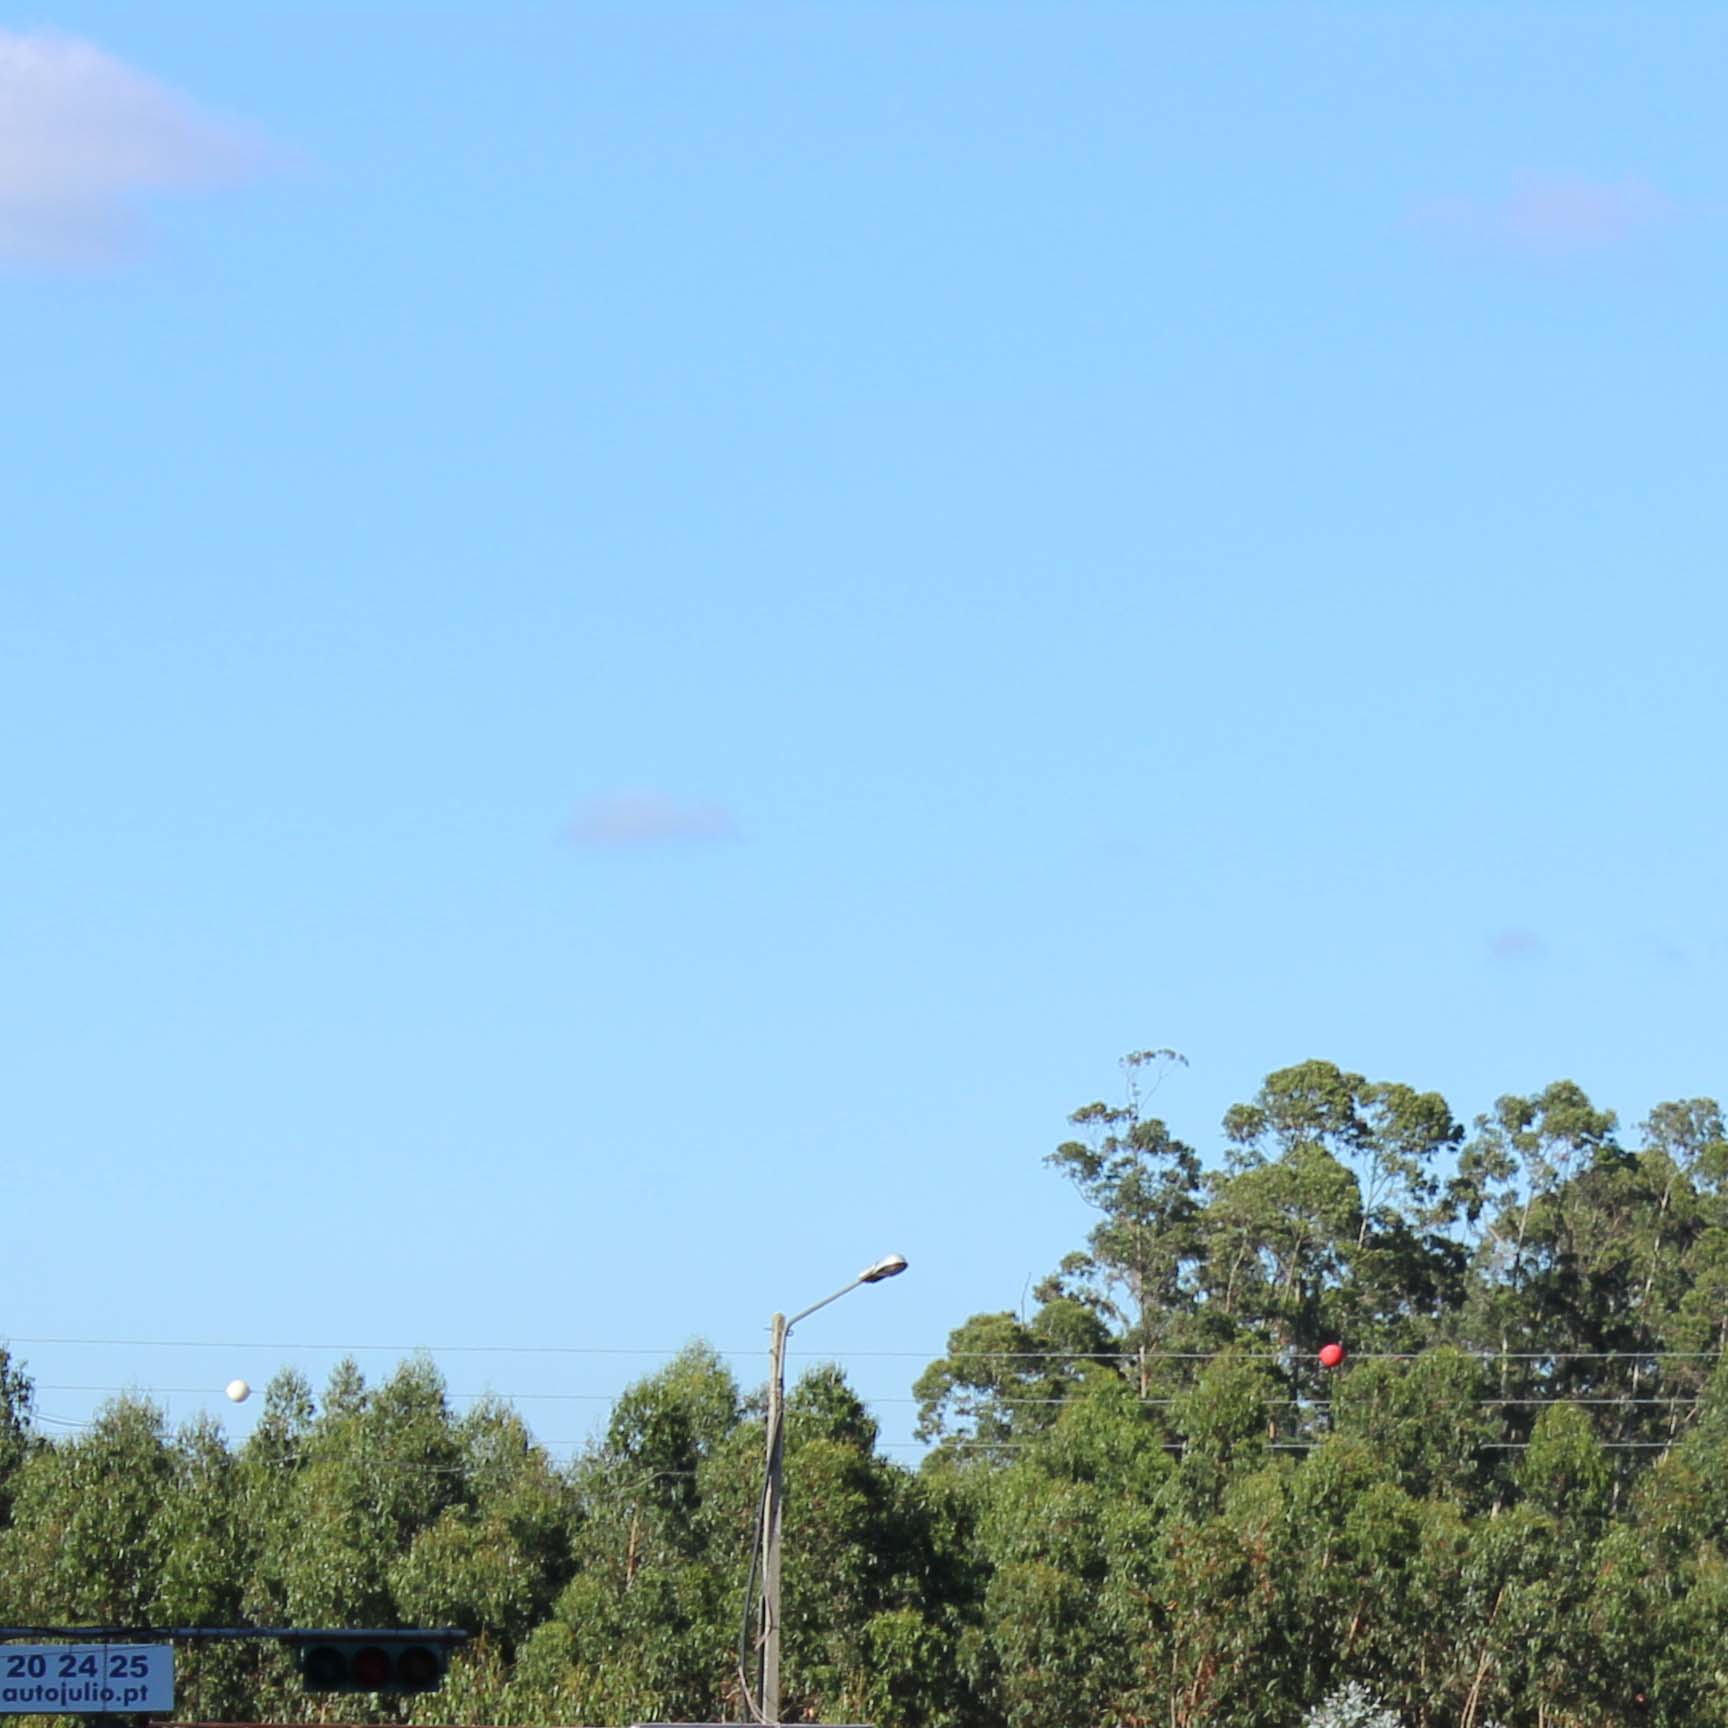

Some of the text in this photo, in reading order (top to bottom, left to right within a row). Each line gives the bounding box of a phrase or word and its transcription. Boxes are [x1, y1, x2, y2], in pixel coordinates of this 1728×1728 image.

[2, 1654, 48, 1679] 20
[58, 1654, 98, 1678] 24
[109, 1654, 149, 1679] 25
